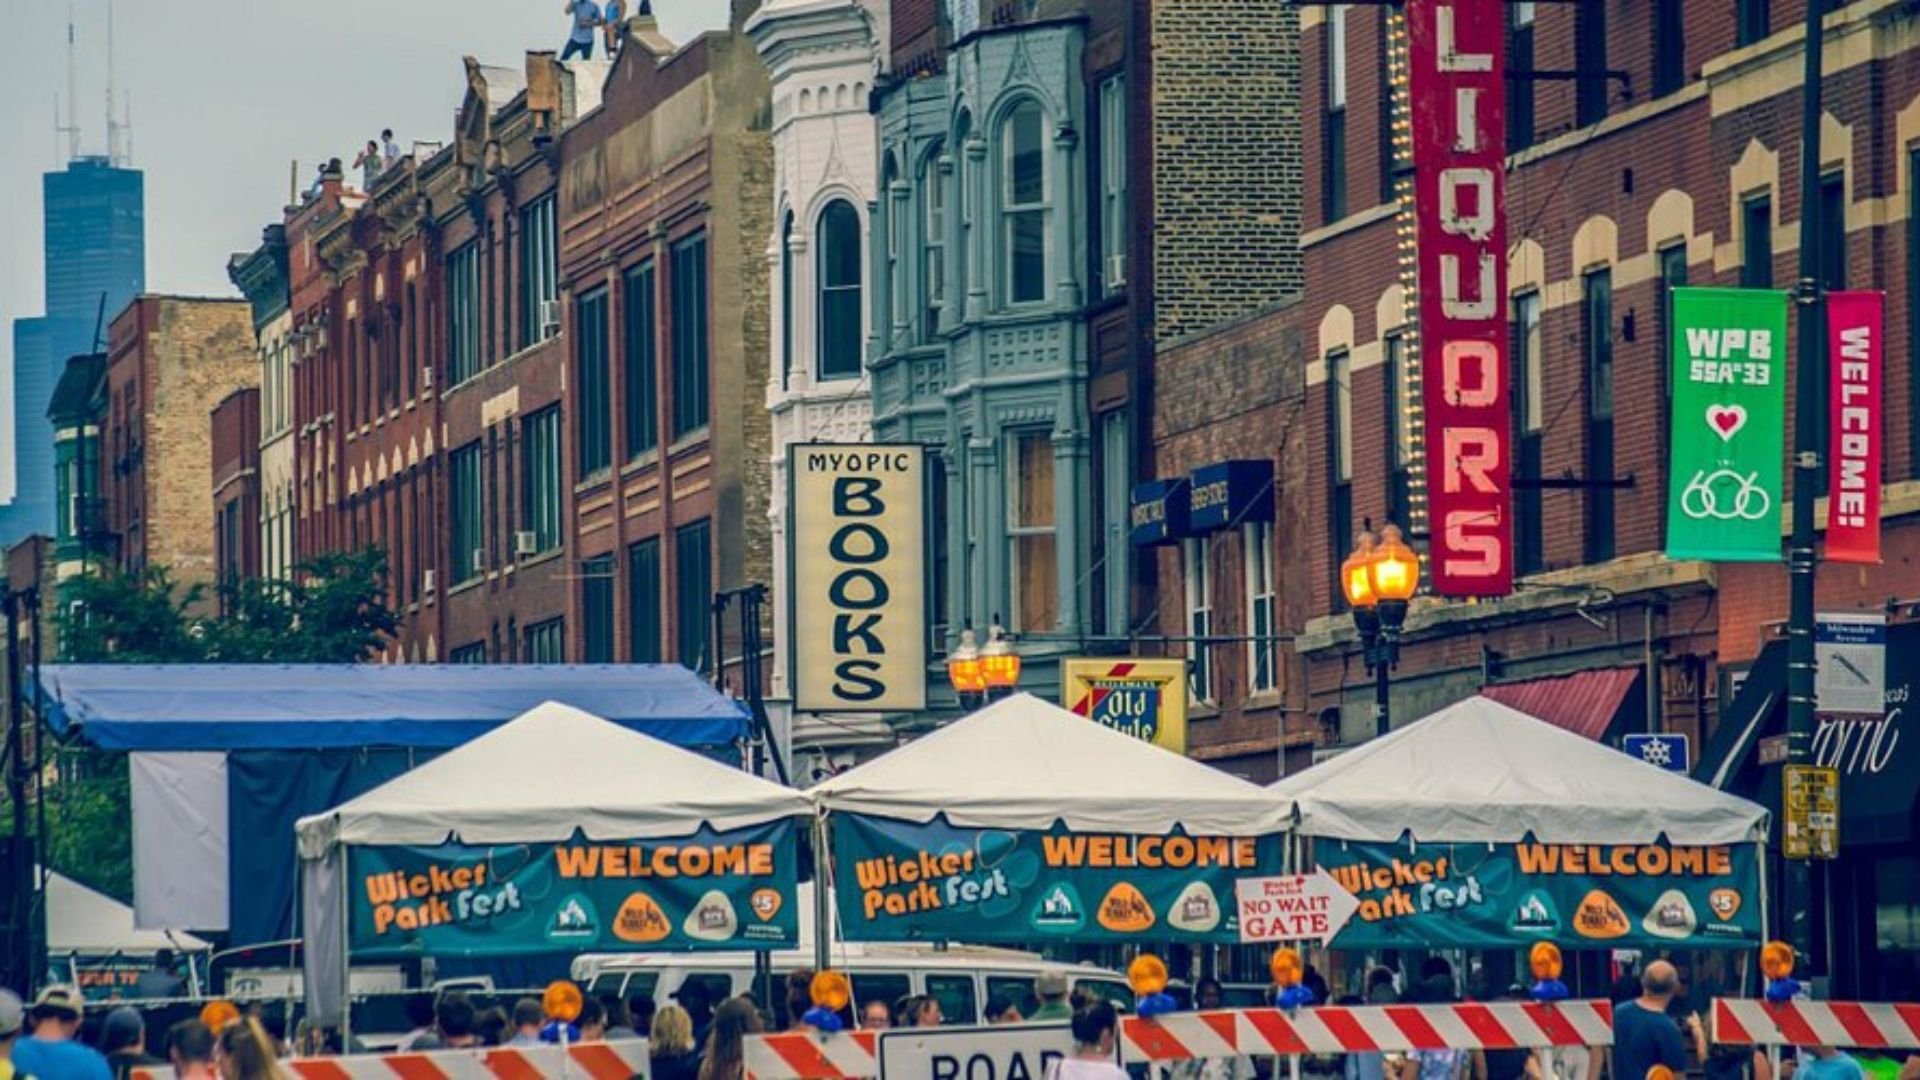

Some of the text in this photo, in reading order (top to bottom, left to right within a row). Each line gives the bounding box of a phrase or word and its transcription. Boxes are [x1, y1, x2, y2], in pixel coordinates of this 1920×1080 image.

[1435, 5, 1500, 578] LIQUORS
[1686, 328, 1771, 360] WPB
[1838, 326, 1870, 527] WELCOME!
[808, 453, 909, 472] MYOPIC
[828, 477, 890, 701] BOOKS
[1108, 690, 1147, 717] Old
[555, 843, 773, 878] WELCOME
[1042, 835, 1256, 868] WELCOME
[1516, 843, 1733, 876] WELCOME
[366, 863, 486, 905] Wicker
[856, 850, 974, 890] Wicker
[1329, 857, 1448, 895] Wicker
[374, 881, 521, 935] Park Fest
[864, 868, 1009, 920] Park Fest
[1243, 895, 1330, 915] NO WAIT
[1359, 875, 1483, 922] ark Fest
[1245, 913, 1329, 938] GATE
[931, 1050, 1066, 1080] ROA
